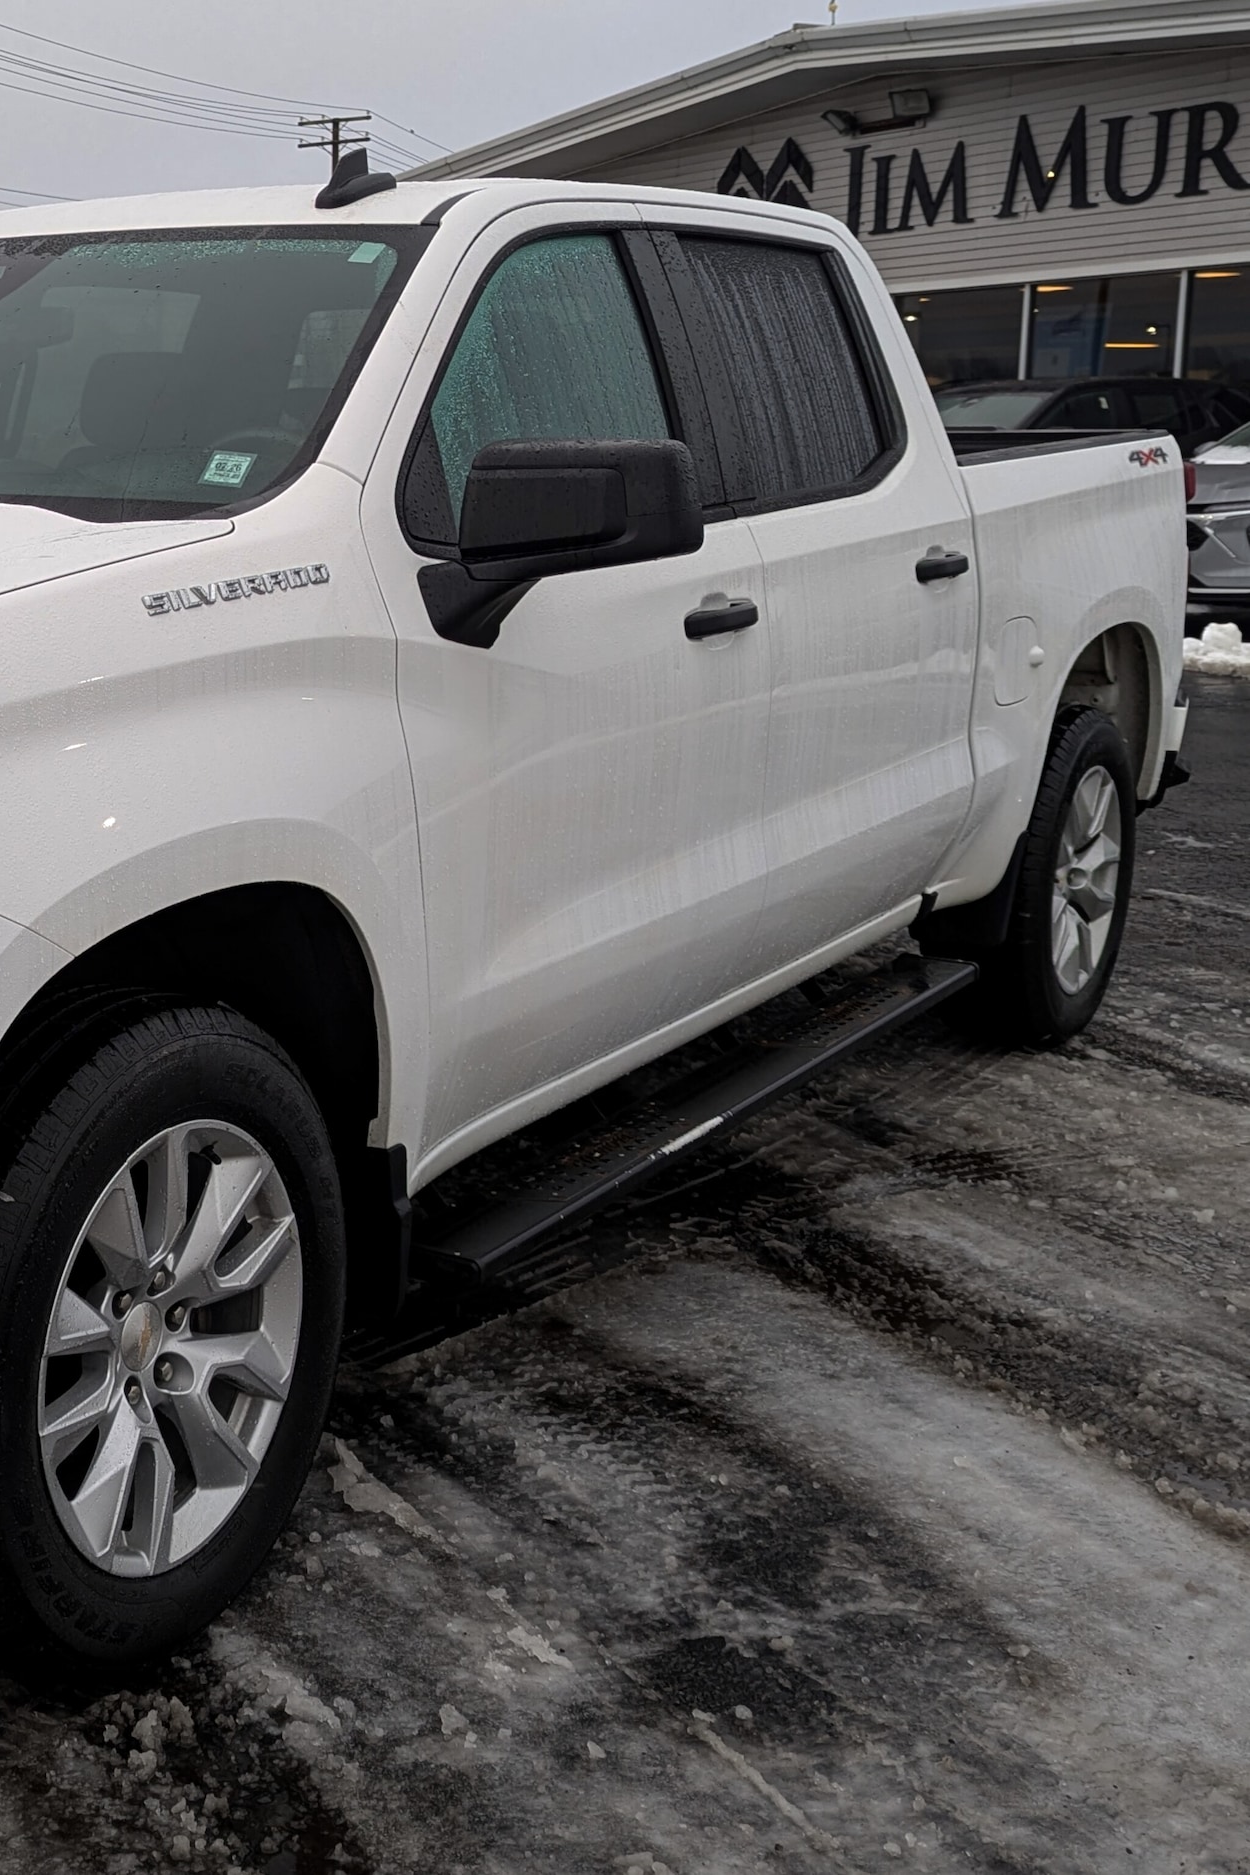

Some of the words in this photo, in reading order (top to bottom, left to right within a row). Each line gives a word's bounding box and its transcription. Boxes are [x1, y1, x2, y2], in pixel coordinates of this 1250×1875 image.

[844, 140, 974, 237] JIM
[141, 563, 331, 617] SILVERADO
[12, 1496, 142, 1641] STARFIRE
